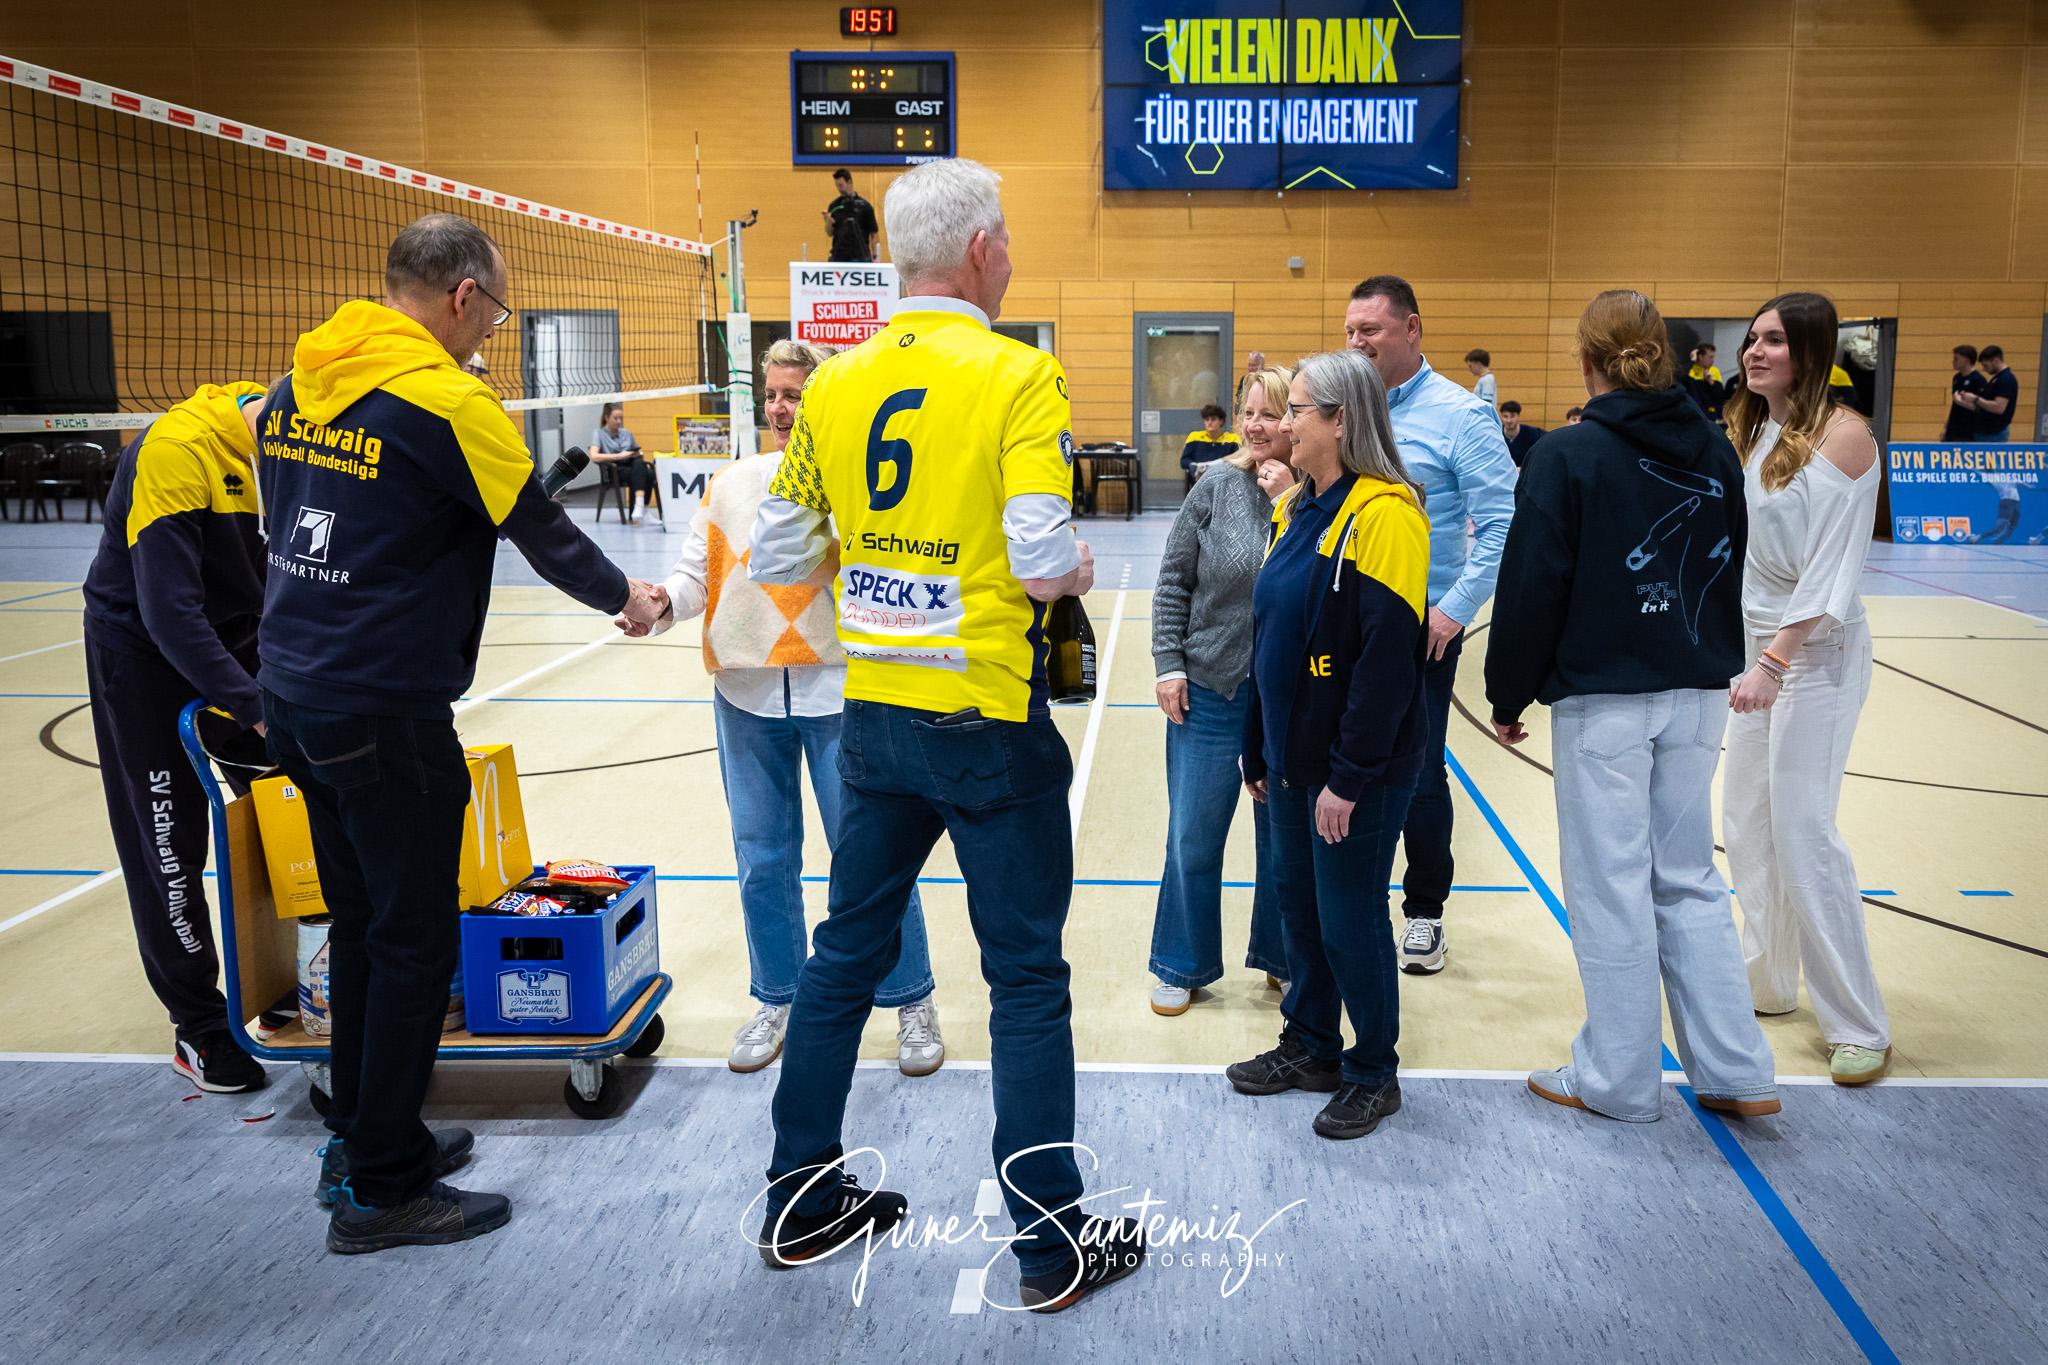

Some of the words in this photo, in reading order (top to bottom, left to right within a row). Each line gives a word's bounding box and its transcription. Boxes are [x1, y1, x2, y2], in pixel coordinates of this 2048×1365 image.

[1164, 18, 1288, 84] VIELEN
[1295, 17, 1399, 84] DANK
[801, 100, 851, 116] HEIM
[895, 100, 944, 116] GAST
[1145, 92, 1190, 145] FÜR
[1194, 98, 1253, 145] EUER
[1257, 98, 1419, 145] ENGAGEMENT
[801, 271, 889, 287] MEYSEL
[815, 302, 874, 320] SCHILDER
[54, 418, 89, 429] FUCHS
[865, 387, 929, 512] 6
[1890, 451, 1924, 470] DYN
[1930, 448, 2045, 470] PRÄSENTIERT
[307, 449, 379, 481] Bundesliga
[1891, 472, 1914, 483] ALLE
[1916, 472, 1947, 483] SPIELE
[1950, 472, 1968, 483] DER
[1970, 473, 1980, 483] 2.
[1981, 473, 2039, 484] BUNDESLIGA
[861, 532, 960, 565] Schwaig
[847, 569, 918, 609] SPECK
[1637, 582, 1669, 594] PUT
[1648, 592, 1660, 601] A
[149, 770, 171, 794] SV
[152, 800, 181, 874] Schwaig
